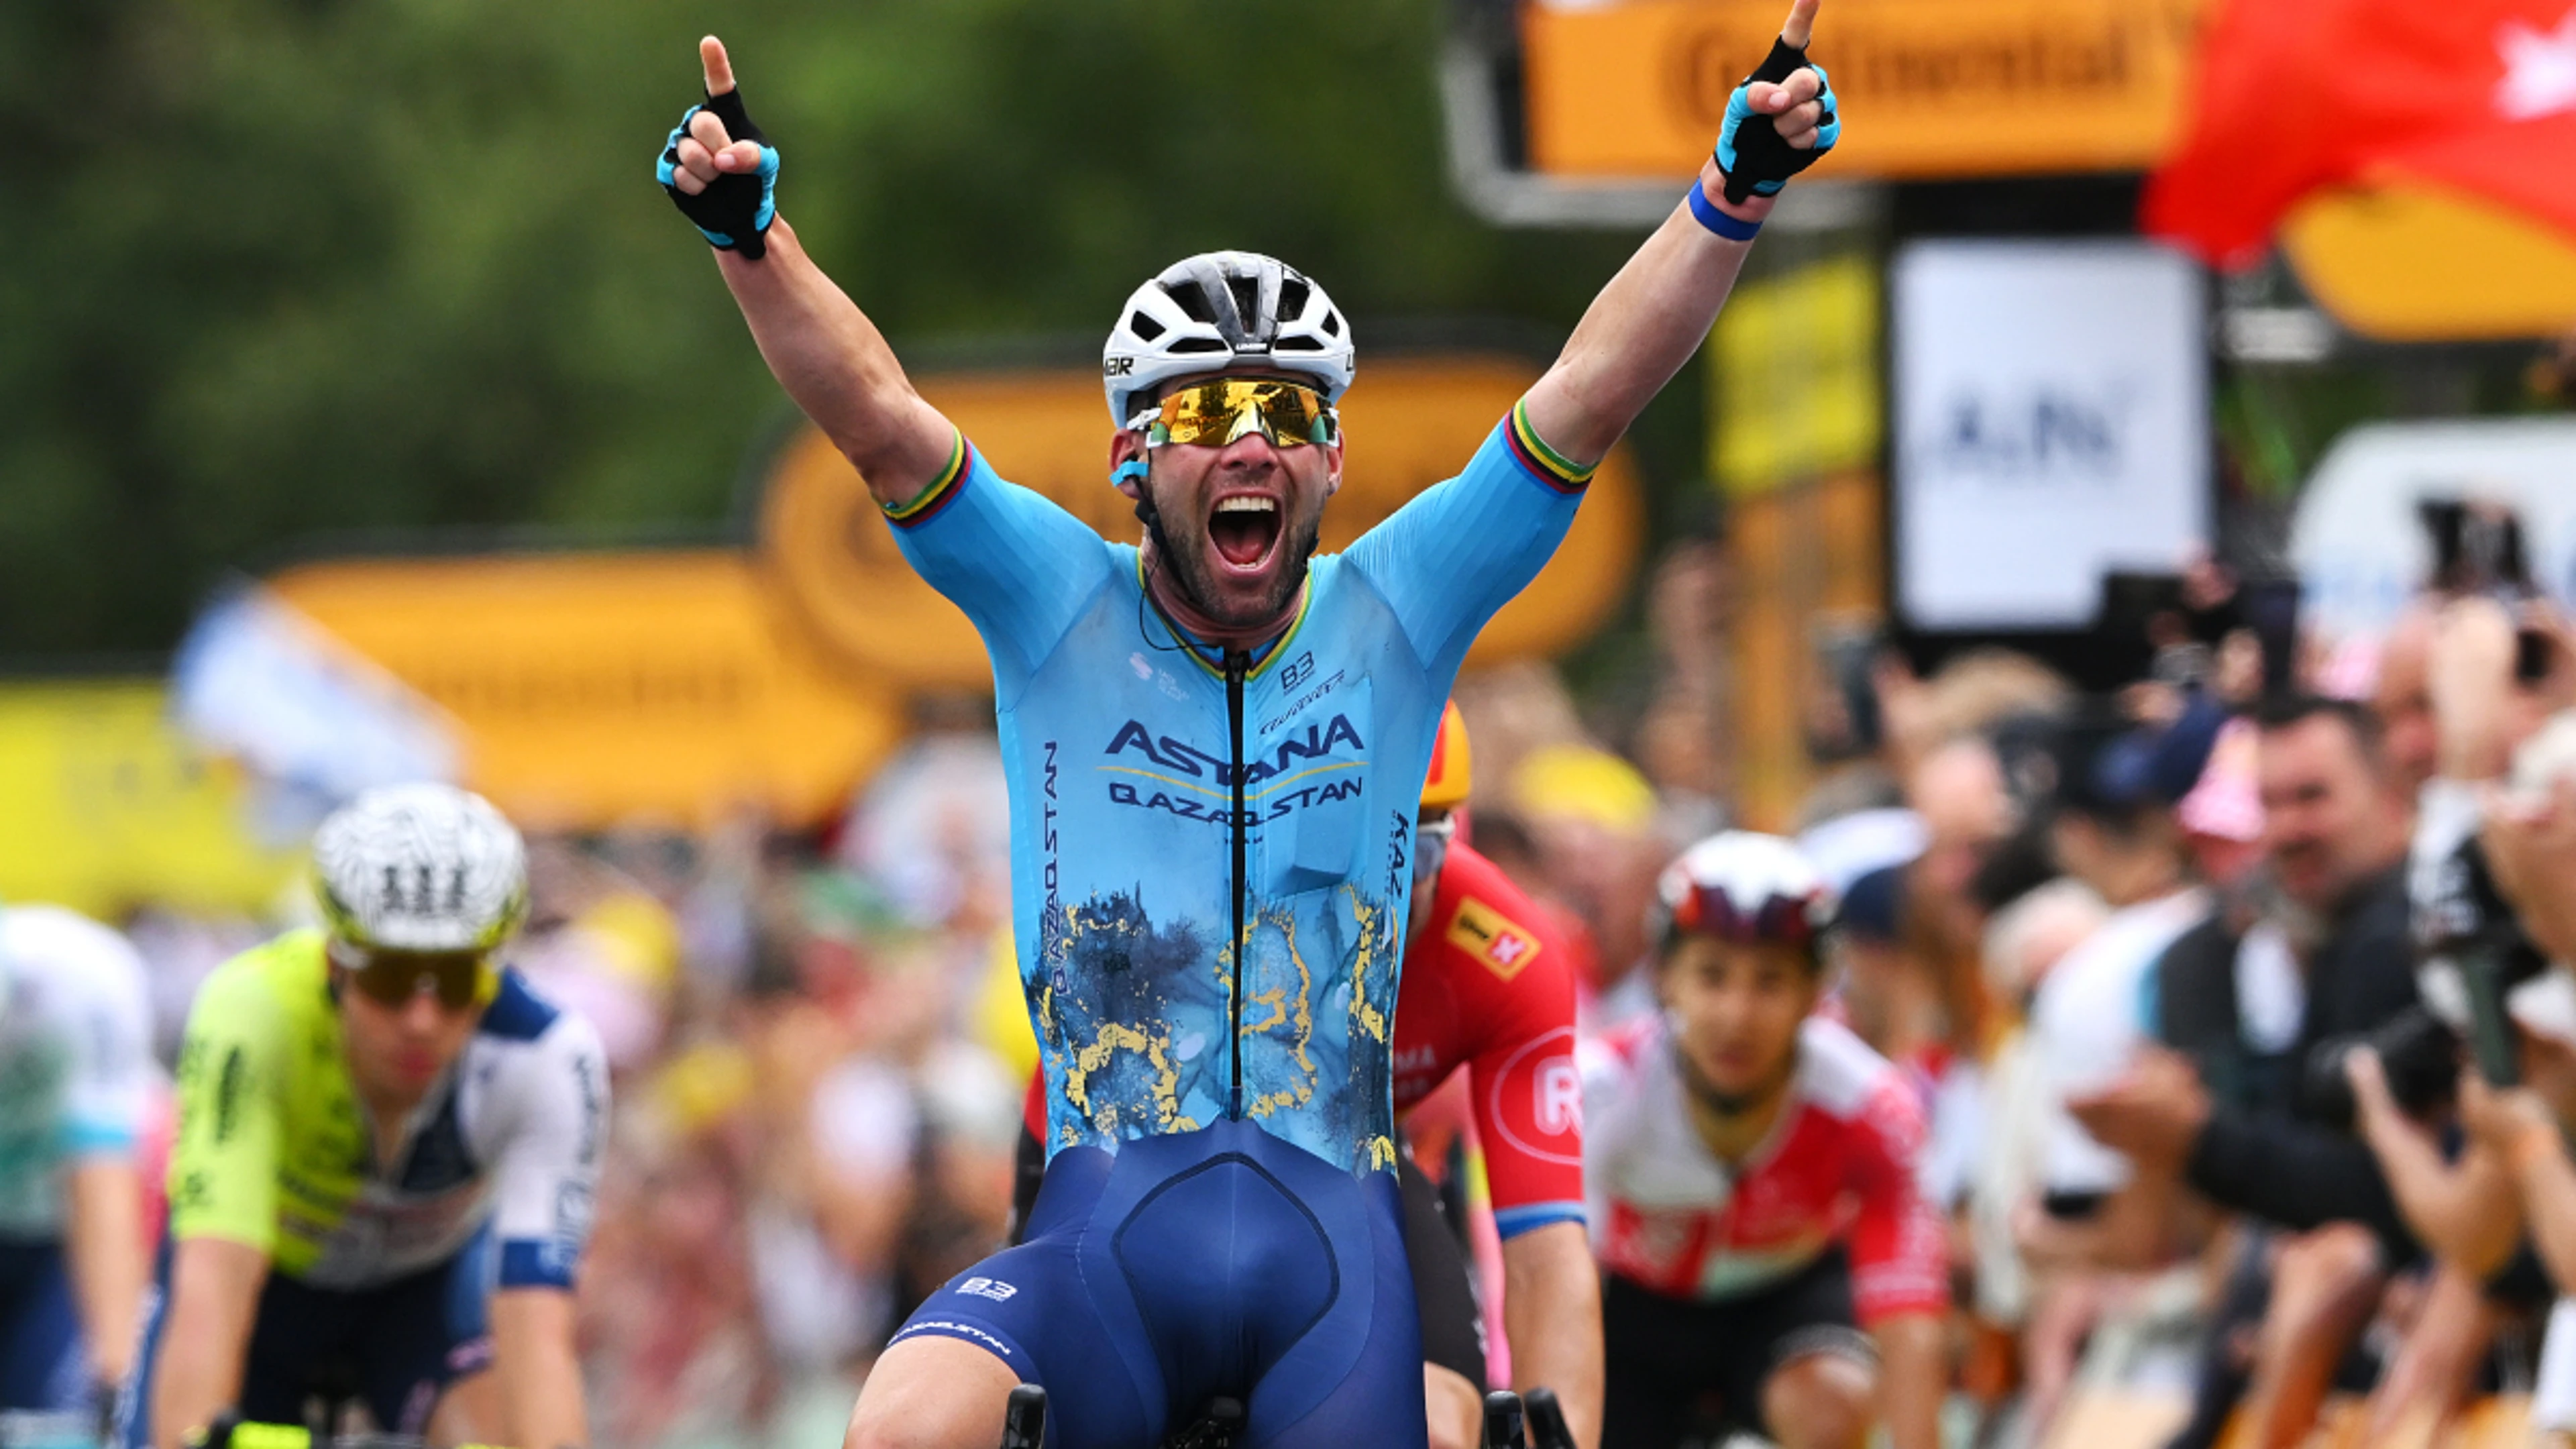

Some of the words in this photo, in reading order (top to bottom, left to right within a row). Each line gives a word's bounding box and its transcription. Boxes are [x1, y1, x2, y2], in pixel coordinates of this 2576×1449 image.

[1281, 650, 1315, 690] B3
[1104, 713, 1364, 787] ASTANA
[1109, 776, 1363, 827] QAZAQSTAN
[1044, 740, 1071, 997] QAZAQSTAN
